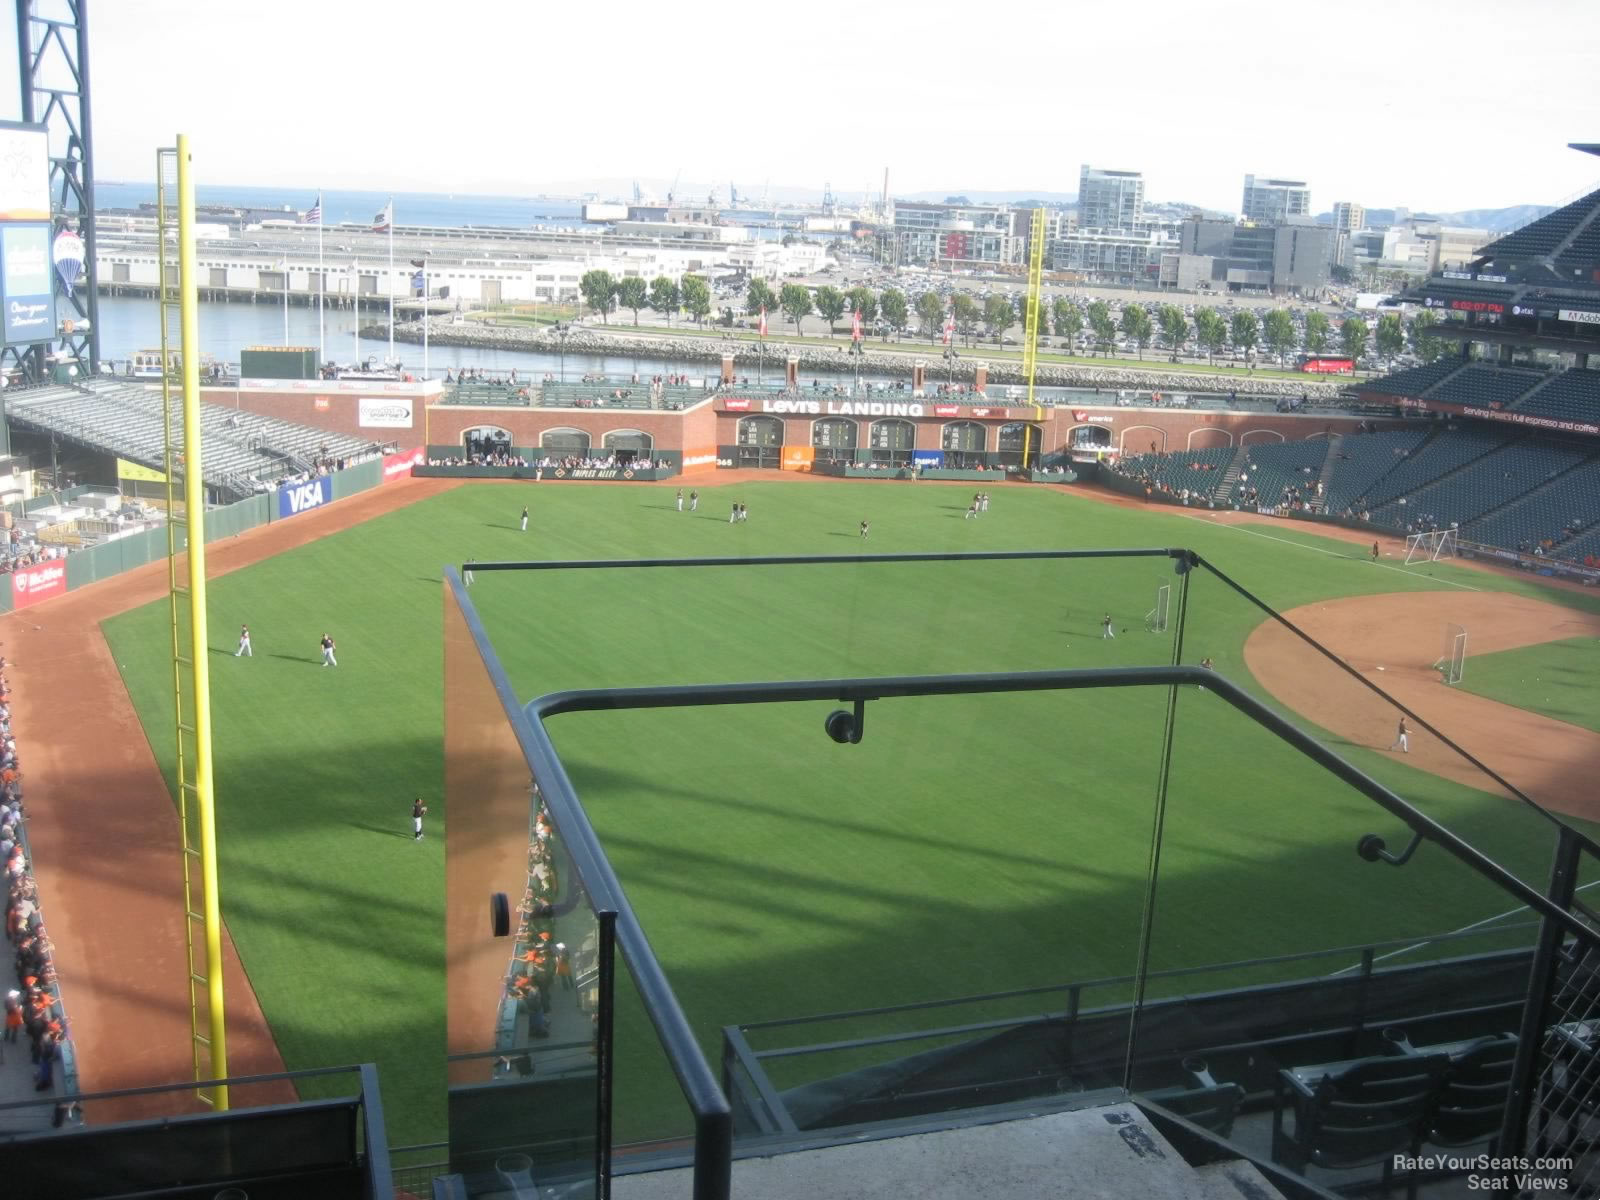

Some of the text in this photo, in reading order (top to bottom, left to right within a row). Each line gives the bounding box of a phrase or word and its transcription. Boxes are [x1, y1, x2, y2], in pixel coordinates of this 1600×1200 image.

[1452, 300, 1504, 312] 6:02:07 PM
[827, 401, 924, 417] LANDING
[1463, 406, 1489, 417] Serving
[1512, 413, 1524, 423] full
[1525, 416, 1558, 428] espresso
[1558, 421, 1573, 430] and
[1574, 423, 1599, 434] coffee
[716, 458, 732, 466] 365
[572, 470, 617, 478] TRIPLES ALLEY
[286, 481, 323, 513] VISA
